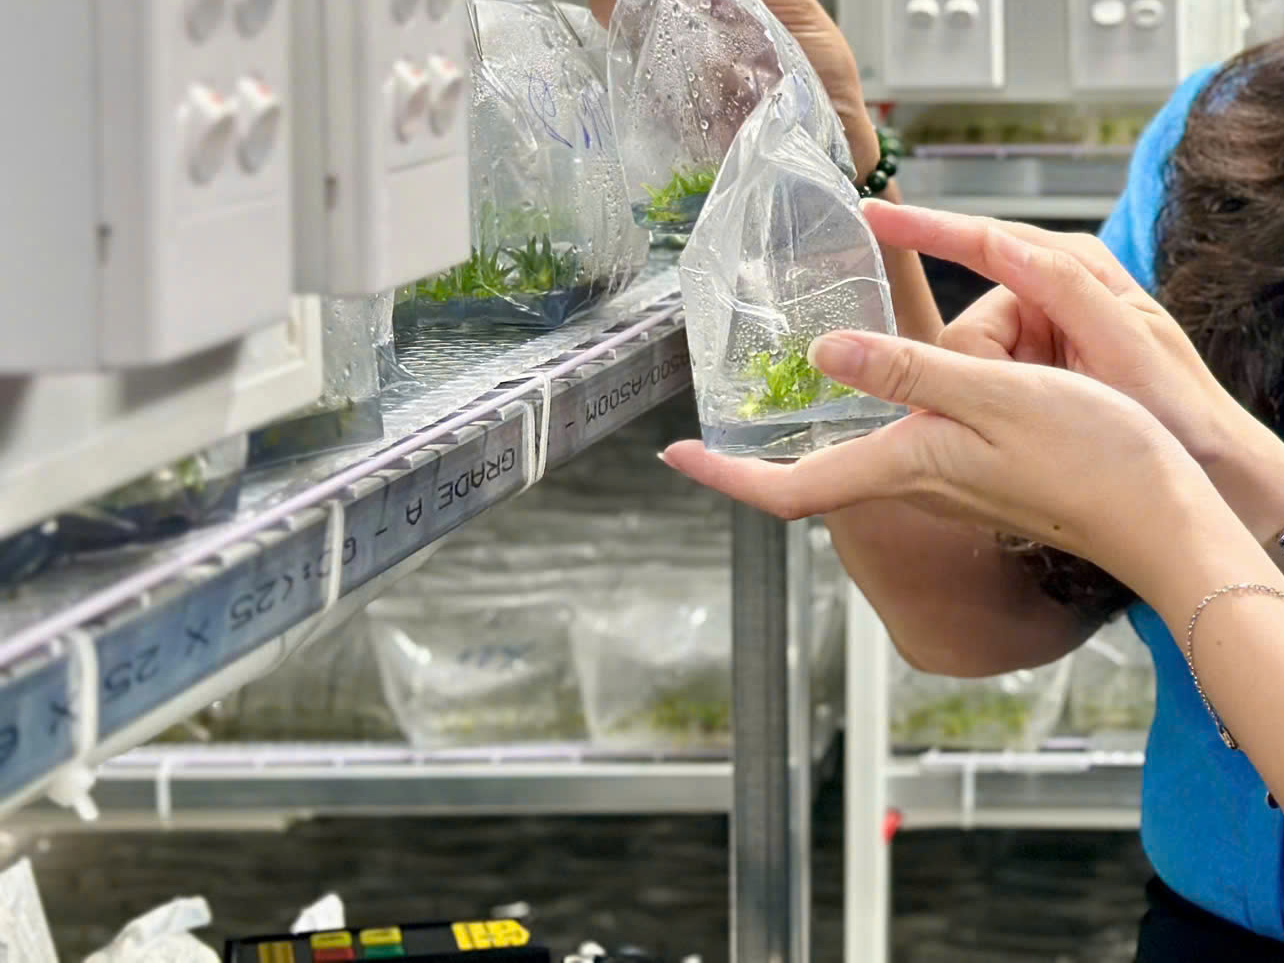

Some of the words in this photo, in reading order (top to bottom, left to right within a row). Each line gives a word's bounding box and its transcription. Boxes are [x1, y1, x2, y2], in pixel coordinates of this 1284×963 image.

[438, 447, 516, 510] GRADE
[405, 497, 423, 526] A
[183, 618, 210, 657] X
[103, 643, 161, 701] 25
